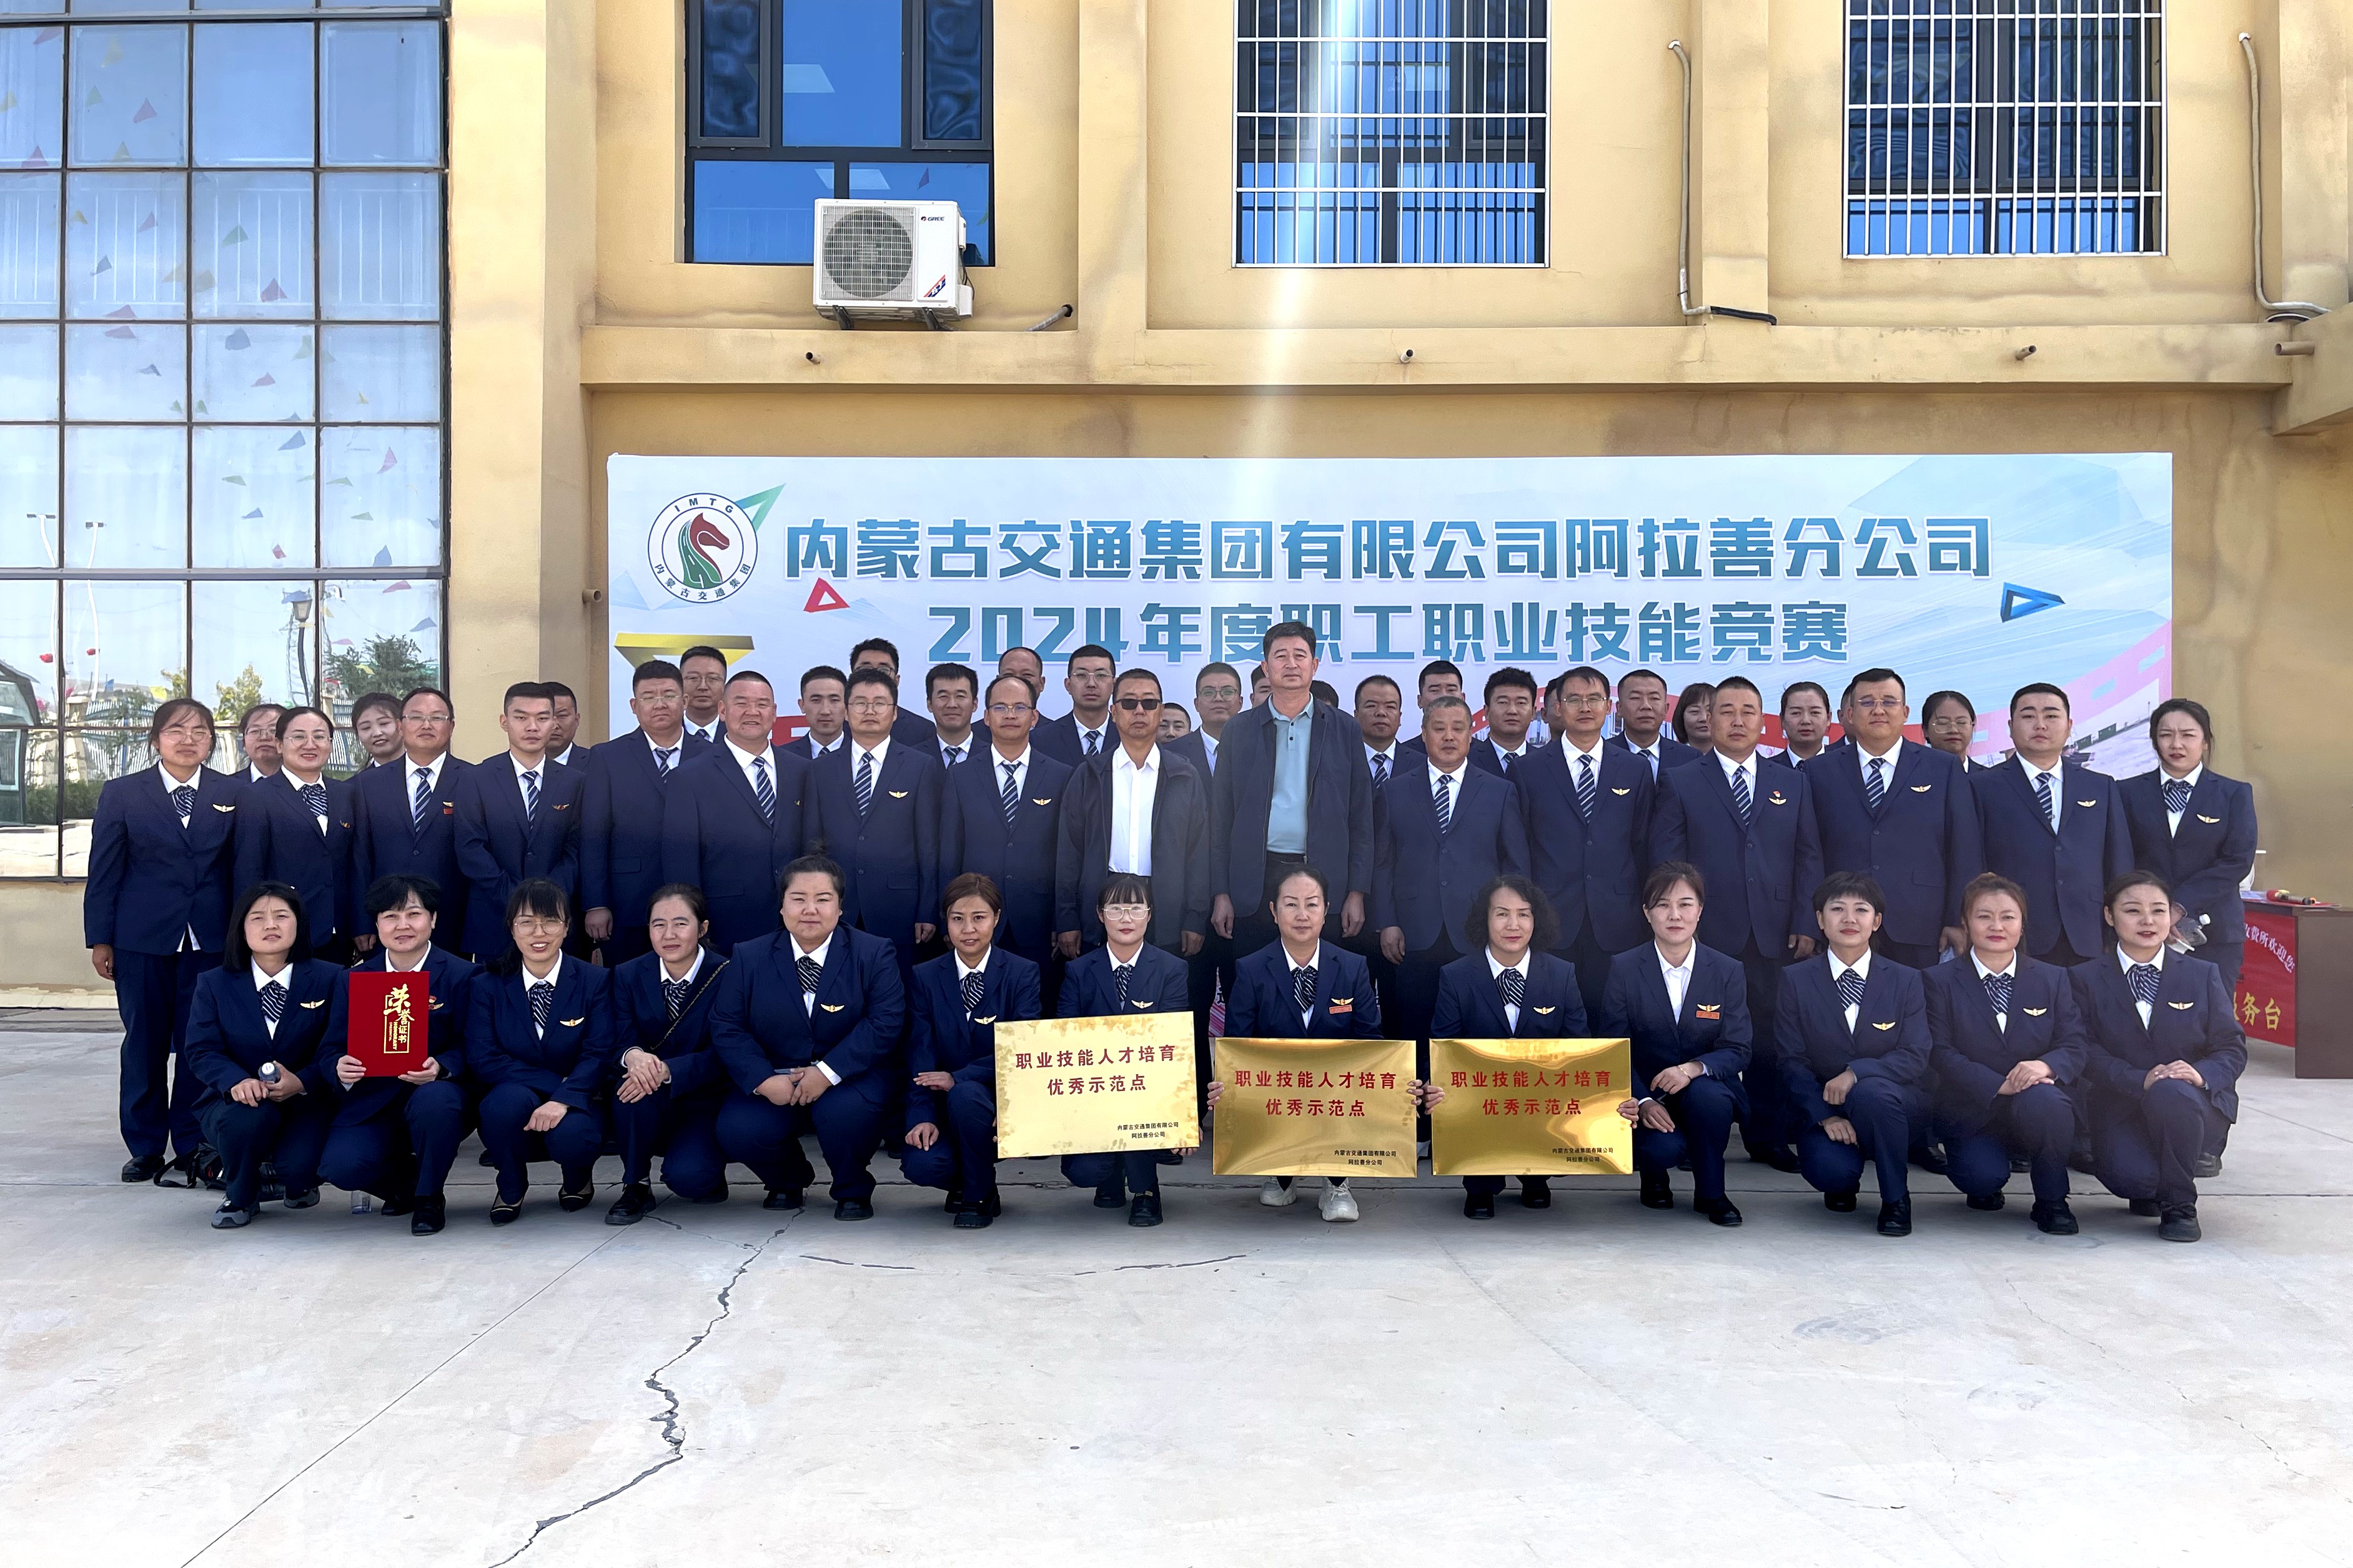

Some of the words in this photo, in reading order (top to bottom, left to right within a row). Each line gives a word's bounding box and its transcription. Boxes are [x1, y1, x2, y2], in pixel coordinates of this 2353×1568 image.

[675, 498, 733, 513] IMTG
[787, 518, 1991, 578] 内蒙古交通集团有限公司阿拉善分公司
[654, 563, 751, 600] 内蒙古交通集团
[928, 602, 1848, 663] 2024年度职工职业技能竞赛
[1015, 1045, 1176, 1070] 职业技能人才培育
[1047, 1073, 1147, 1096] 优秀示范点
[1234, 1070, 1397, 1090] 职业技能人才培育
[1450, 1070, 1612, 1088] 职业技能人才培育
[1266, 1098, 1365, 1117] 优秀示范点
[1482, 1098, 1582, 1115] 优秀示范点
[1117, 1122, 1179, 1131] 内蒙古交通集团有限公司
